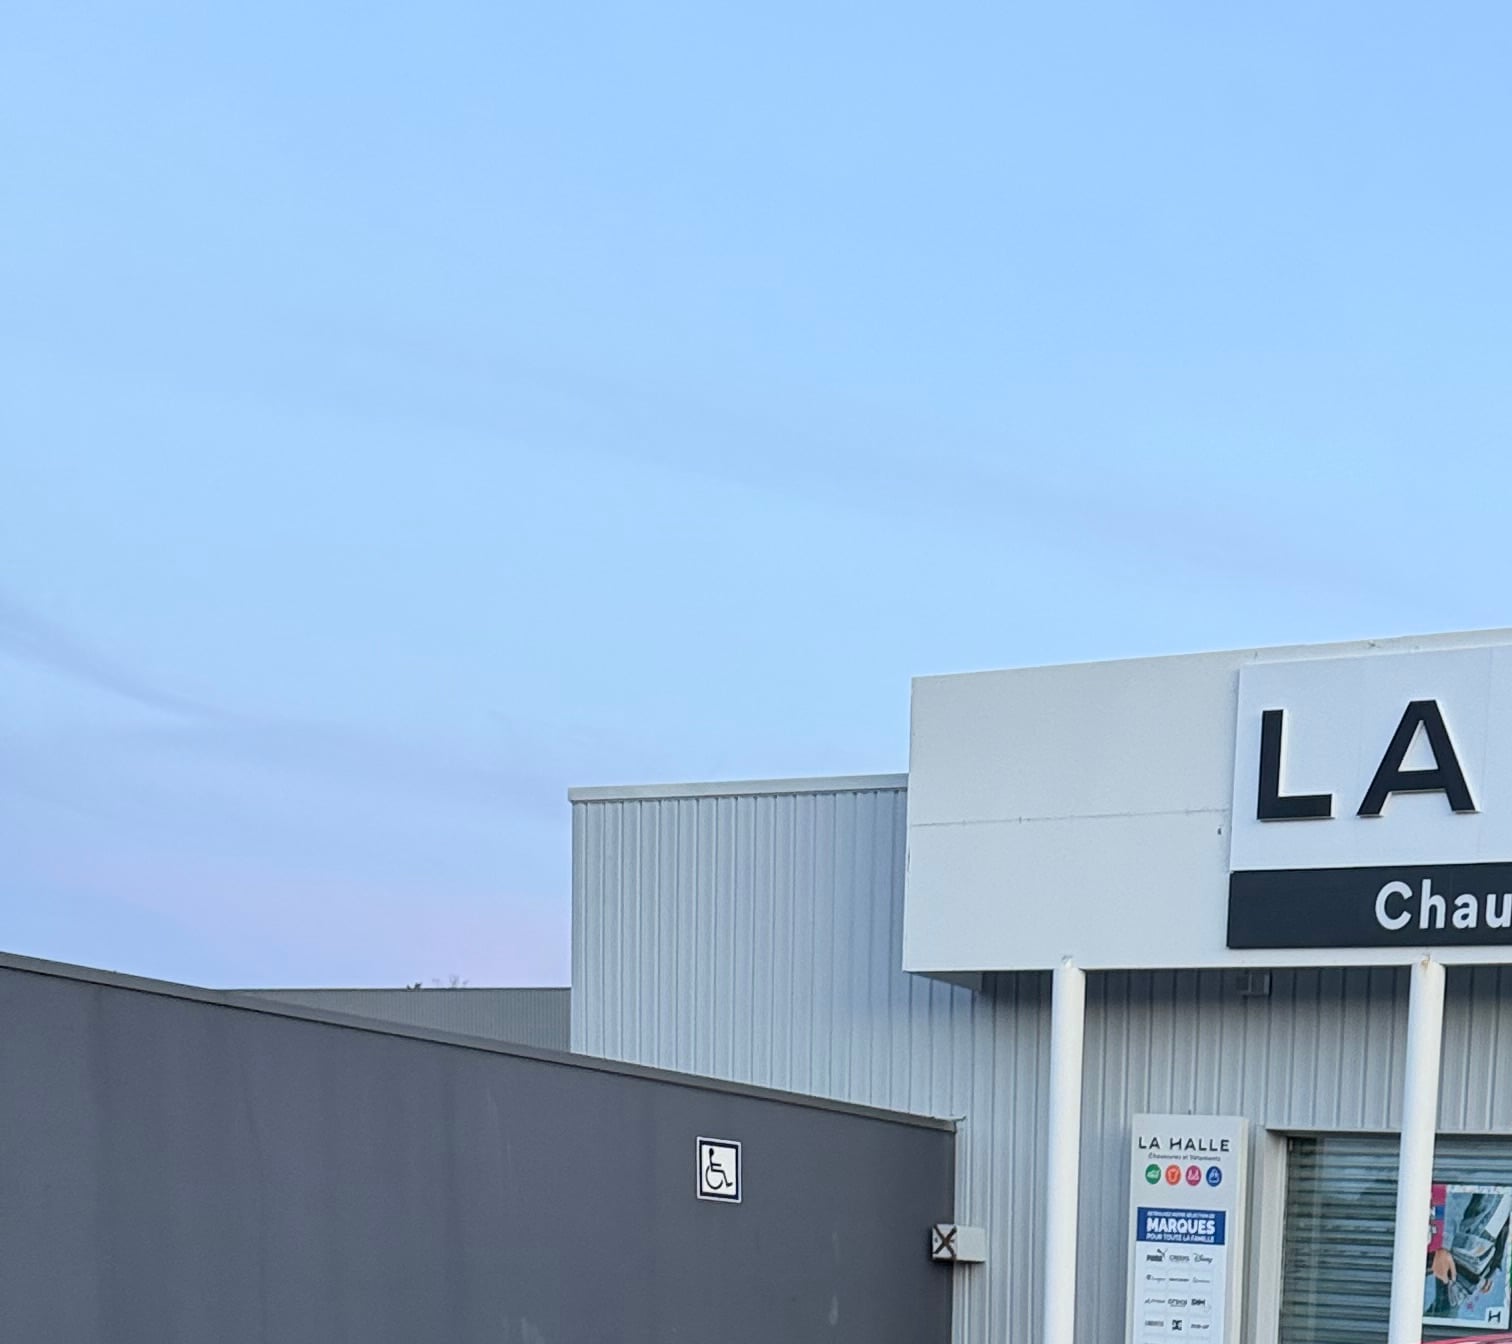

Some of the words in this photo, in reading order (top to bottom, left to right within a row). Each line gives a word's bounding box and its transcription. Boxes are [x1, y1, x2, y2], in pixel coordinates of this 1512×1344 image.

[1256, 699, 1479, 822] LA
[1138, 1136, 1161, 1150] LA
[1169, 1137, 1230, 1152] HALLE
[1146, 1217, 1216, 1235] MARQUES
